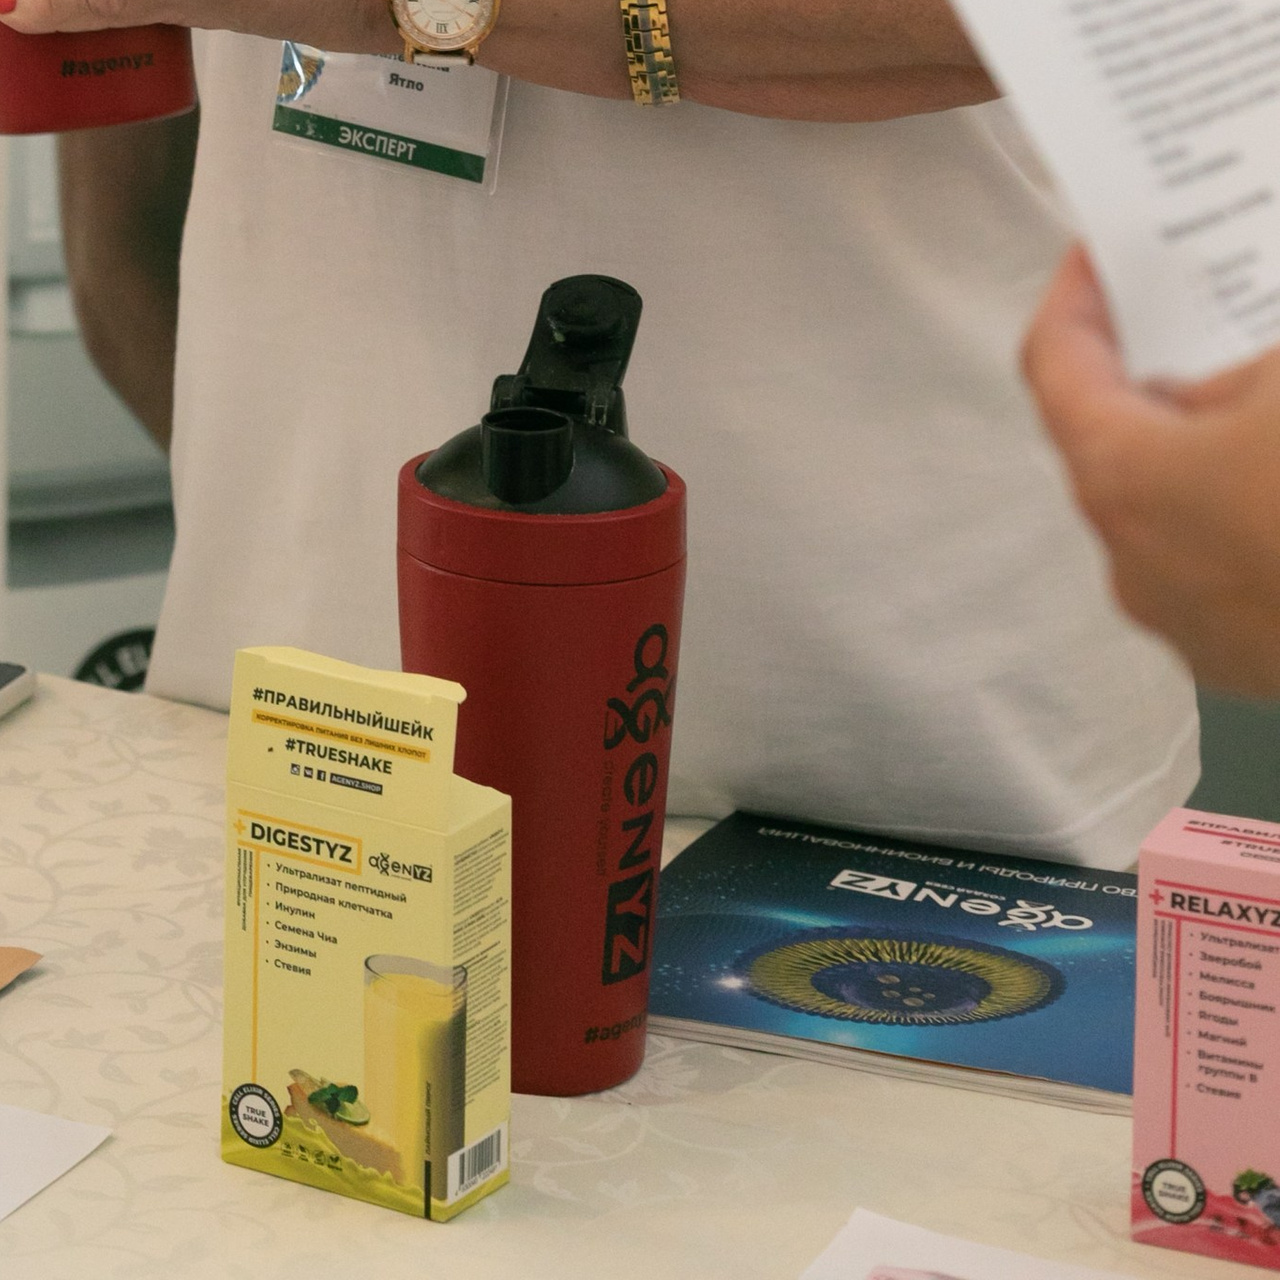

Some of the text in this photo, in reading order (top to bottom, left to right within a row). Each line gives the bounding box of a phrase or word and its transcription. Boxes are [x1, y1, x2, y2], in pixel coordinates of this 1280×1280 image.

[338, 126, 417, 161] ЭКСПЕРТ
[253, 687, 434, 741] #ПРАВИЛЬНЫЙШЕЙК
[315, 726, 349, 741] ПИТАНИЯ
[350, 735, 363, 744] БЕЗ
[397, 745, 427, 759] ХЛОПОТ
[285, 738, 393, 774] #TRUESHAKE
[331, 775, 382, 793] AGENYZ.SHOP
[250, 822, 353, 864] DIGESTYZ
[275, 863, 407, 904] Ультрализат пептидный
[978, 865, 1099, 892] ПРИРОДЫ
[275, 882, 393, 920] Природная клетчатка
[275, 901, 316, 920] Инулин
[274, 920, 338, 945] Семена Чиа
[274, 939, 317, 959] Энзимы
[274, 958, 312, 977] Стевия
[1200, 951, 1262, 971] Зверобой
[1199, 971, 1256, 990] Мелисса
[1198, 1010, 1239, 1026] Ягоды
[1197, 1030, 1248, 1047] Магний
[1197, 1049, 1264, 1070] Витамины
[1197, 1064, 1246, 1081] группы
[1195, 1083, 1241, 1100] Стевия
[242, 1113, 270, 1128] SHAKE
[245, 1105, 267, 1118] TRUE
